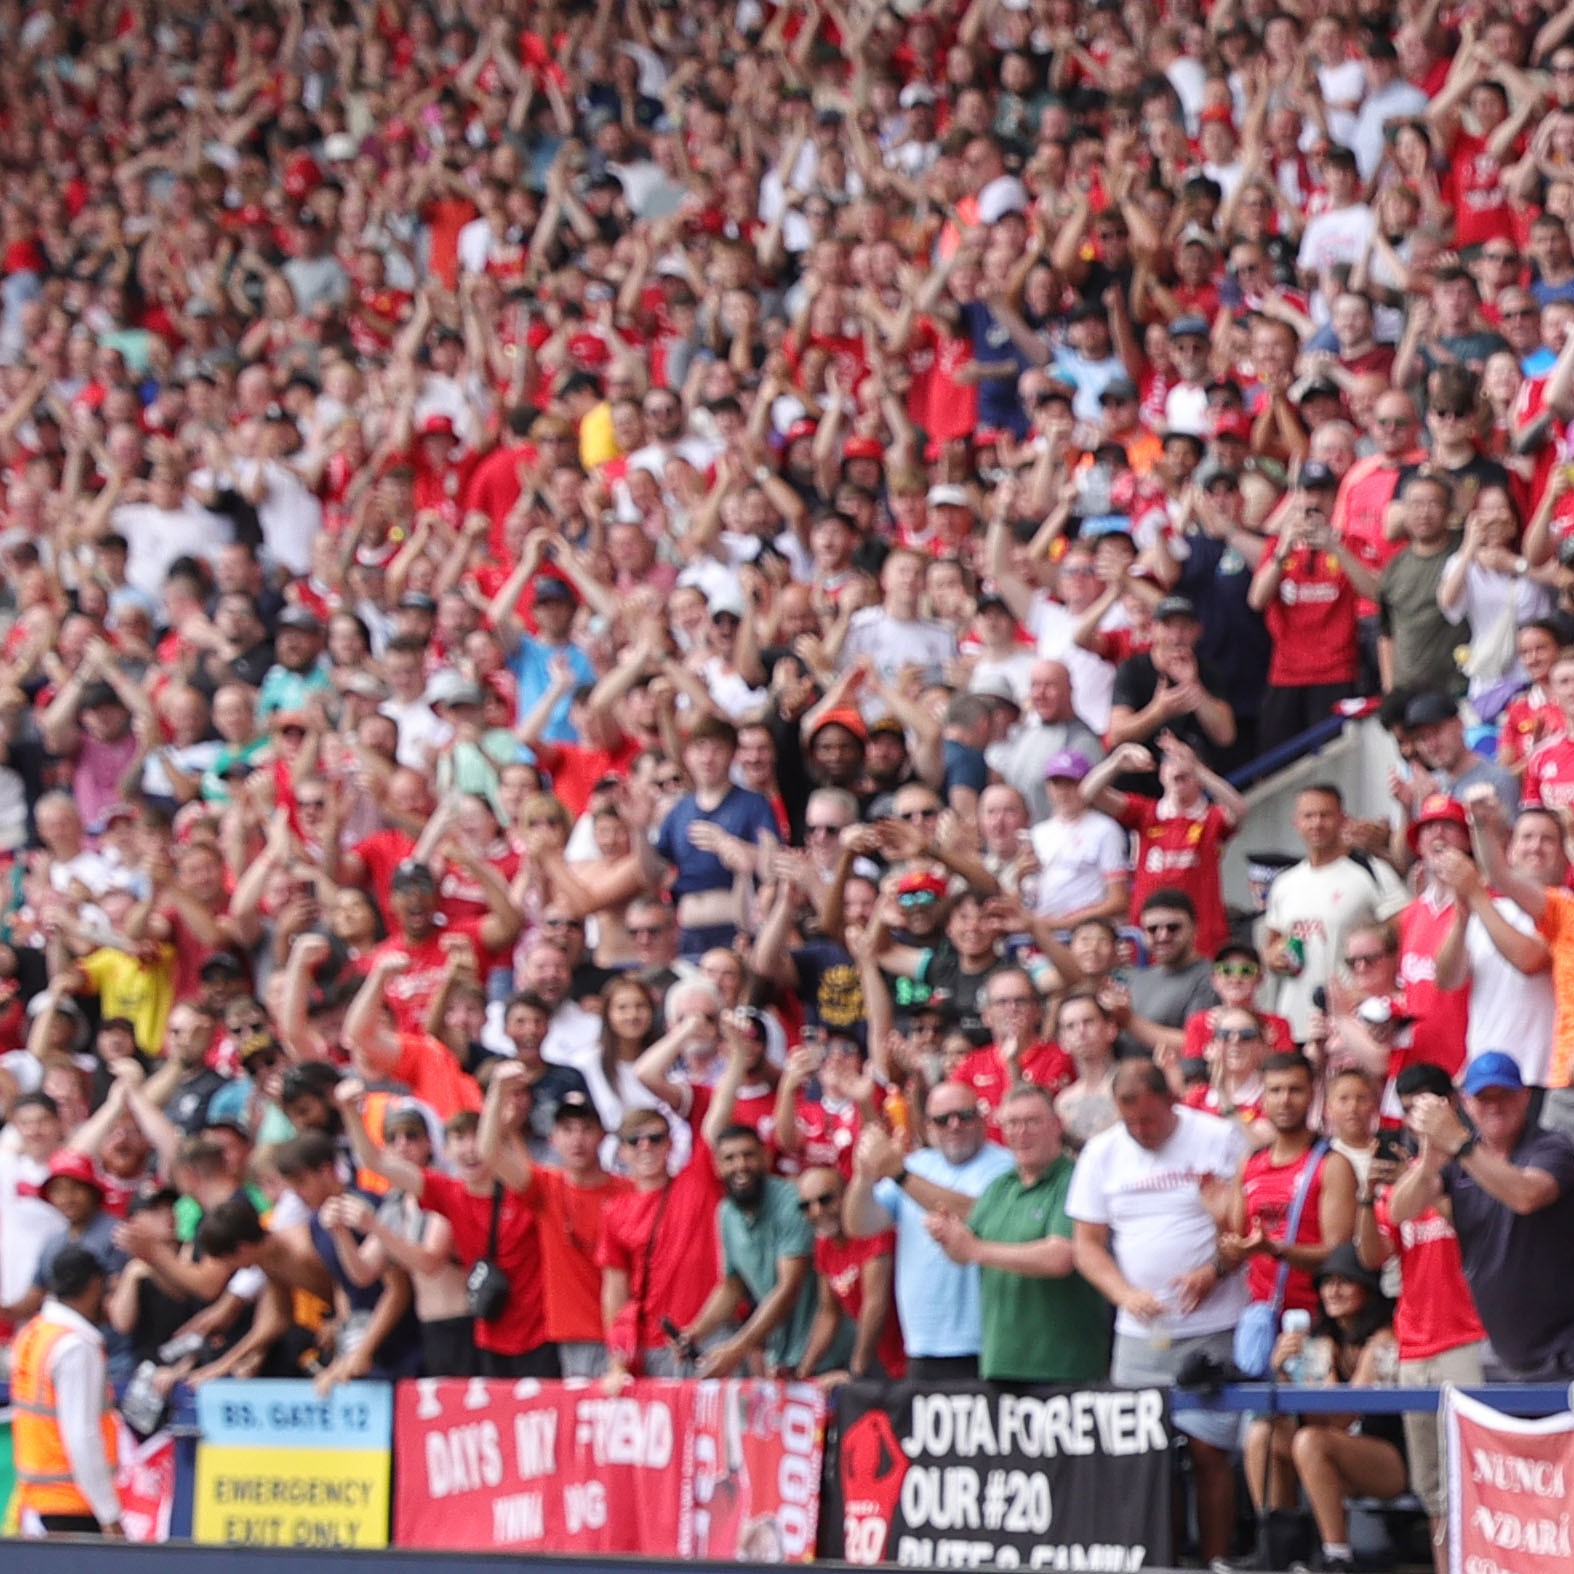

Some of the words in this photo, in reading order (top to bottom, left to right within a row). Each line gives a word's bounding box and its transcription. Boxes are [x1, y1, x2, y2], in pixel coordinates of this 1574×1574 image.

[268, 1402, 330, 1430] GATE
[342, 1404, 370, 1431] 12
[902, 1394, 998, 1458] JOTA
[999, 1389, 1169, 1457] FOREVER
[425, 1419, 503, 1499] DAYS
[214, 1477, 374, 1507] EMERGENCY
[901, 1465, 981, 1531] OUR
[983, 1468, 1052, 1535] #20
[227, 1518, 284, 1547] EXIT
[293, 1519, 361, 1548] ONLY
[843, 1516, 888, 1565] 20
